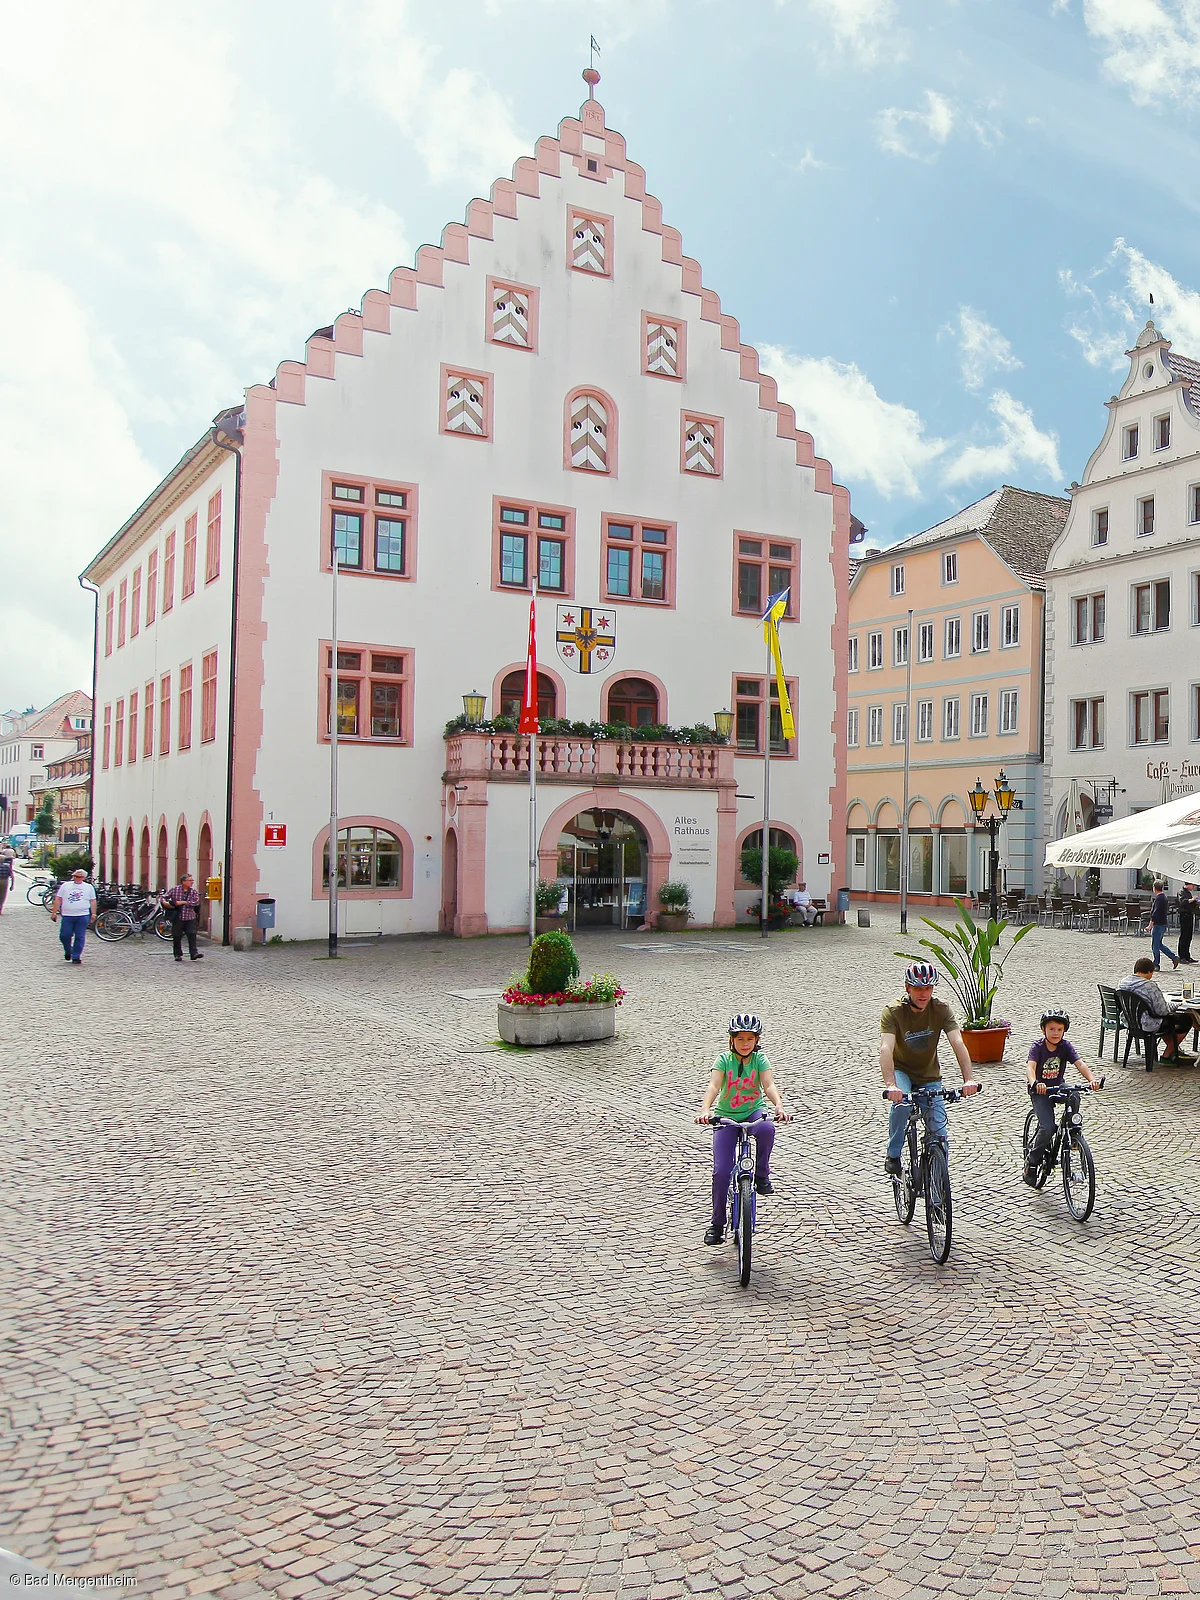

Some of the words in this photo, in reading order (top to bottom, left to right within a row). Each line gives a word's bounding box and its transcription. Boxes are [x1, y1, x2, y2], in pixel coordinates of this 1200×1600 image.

[1146, 761, 1170, 781] Café
[268, 811, 274, 820] 1
[674, 816, 698, 825] Altes
[674, 826, 710, 835] Rathaus
[1056, 847, 1127, 866] Herbsthäuser
